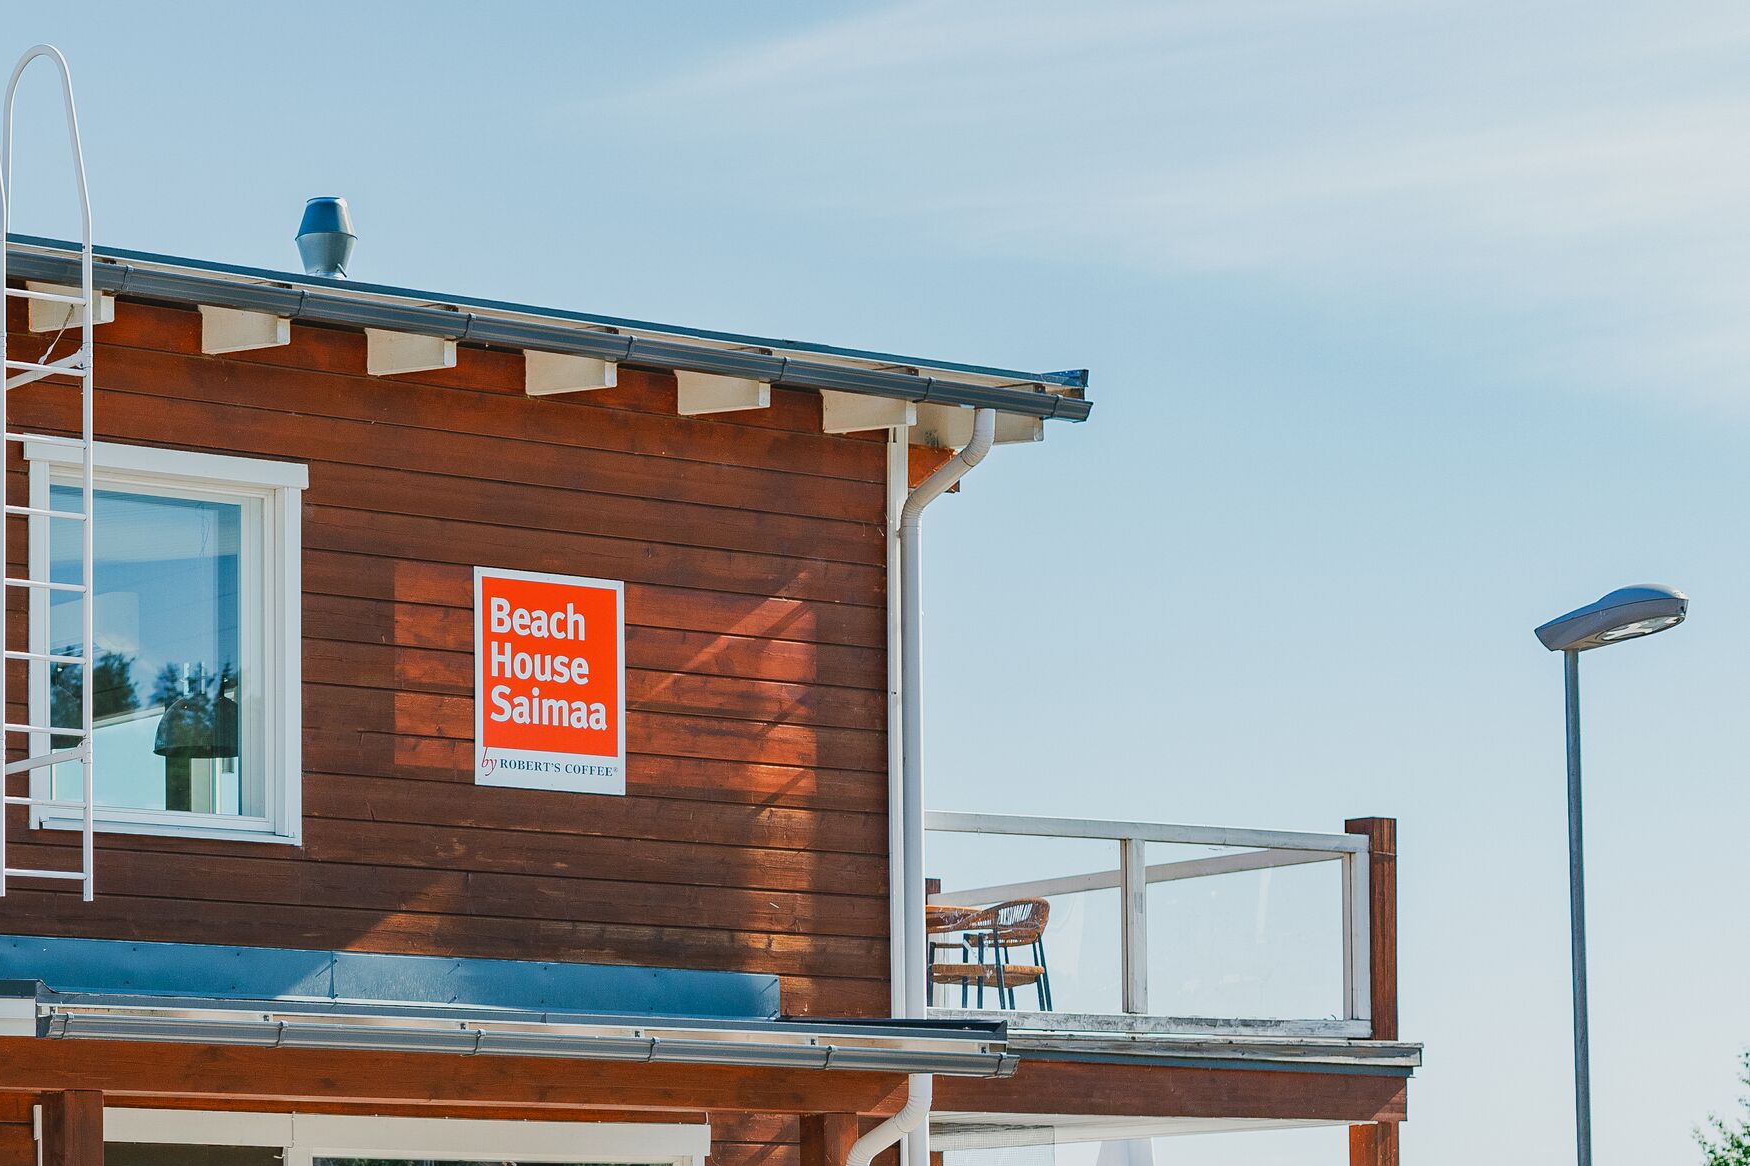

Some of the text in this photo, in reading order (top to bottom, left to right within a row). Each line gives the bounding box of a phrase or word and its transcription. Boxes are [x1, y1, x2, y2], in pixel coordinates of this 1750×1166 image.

[490, 596, 586, 641] Beach
[491, 641, 590, 685] House
[490, 684, 608, 731] Saimaa
[481, 746, 497, 776] by
[499, 758, 561, 773] ROBERT'S
